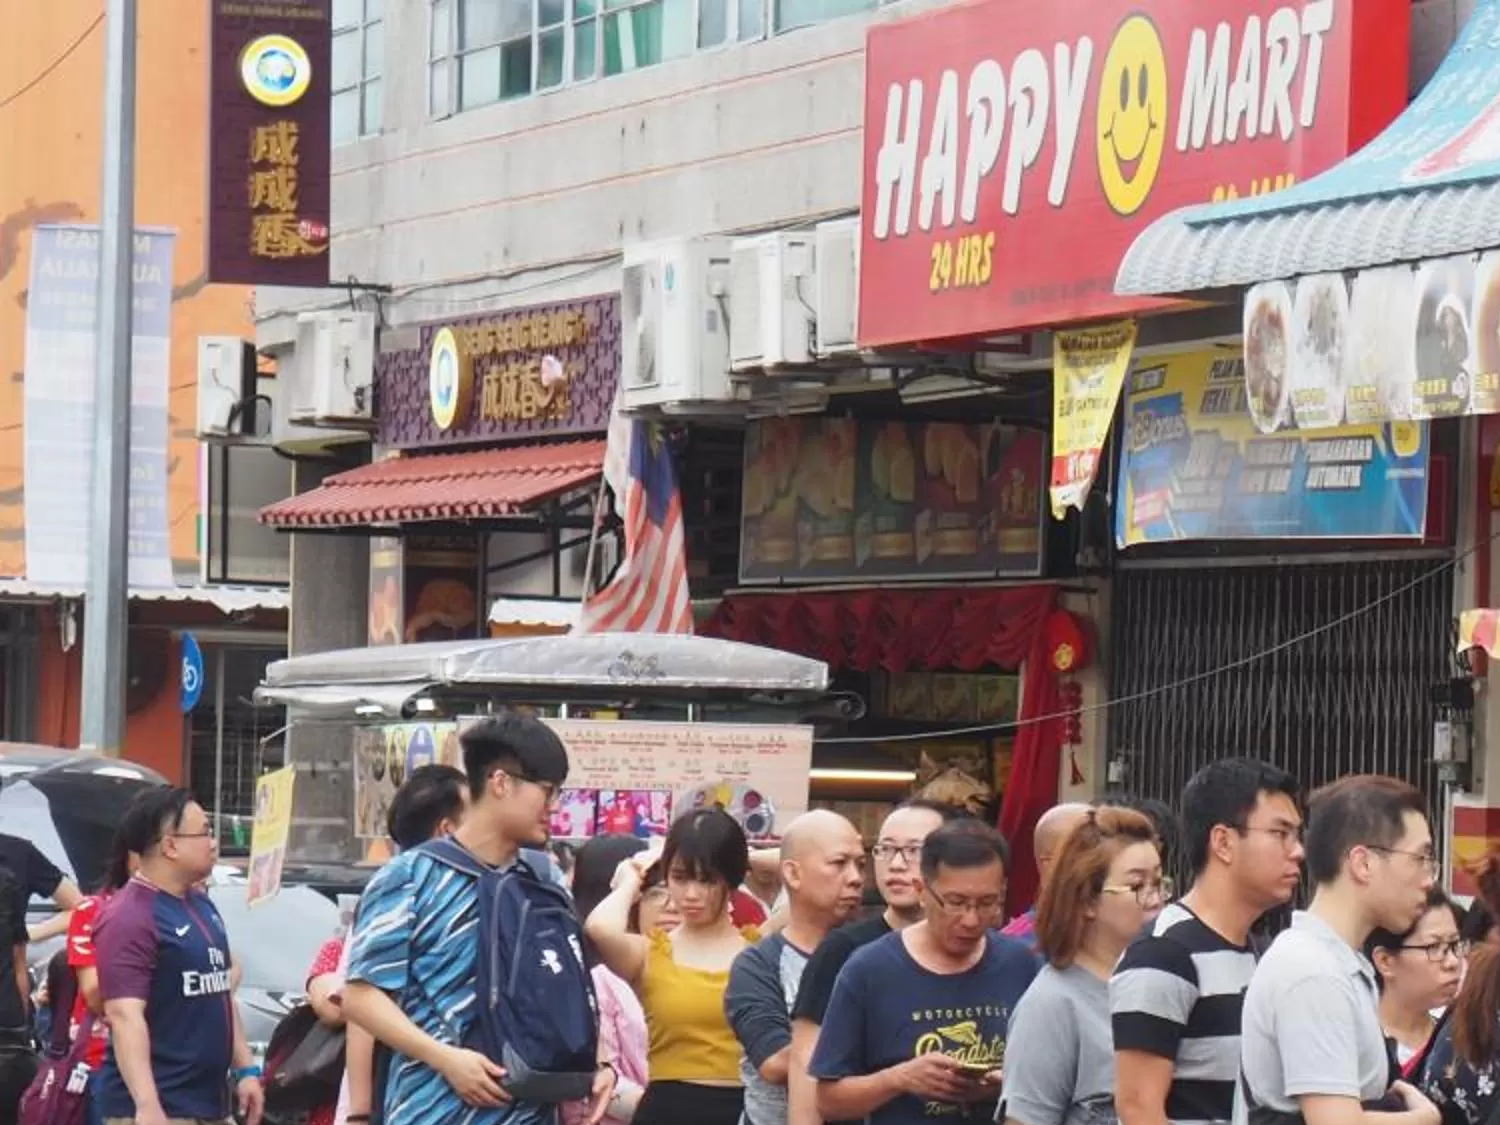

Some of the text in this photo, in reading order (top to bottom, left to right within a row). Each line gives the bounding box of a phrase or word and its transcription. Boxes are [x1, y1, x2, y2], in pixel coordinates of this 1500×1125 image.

[873, 36, 1094, 240] HAPPY
[1176, 0, 1335, 153] MART
[929, 231, 995, 291] 24 HRS
